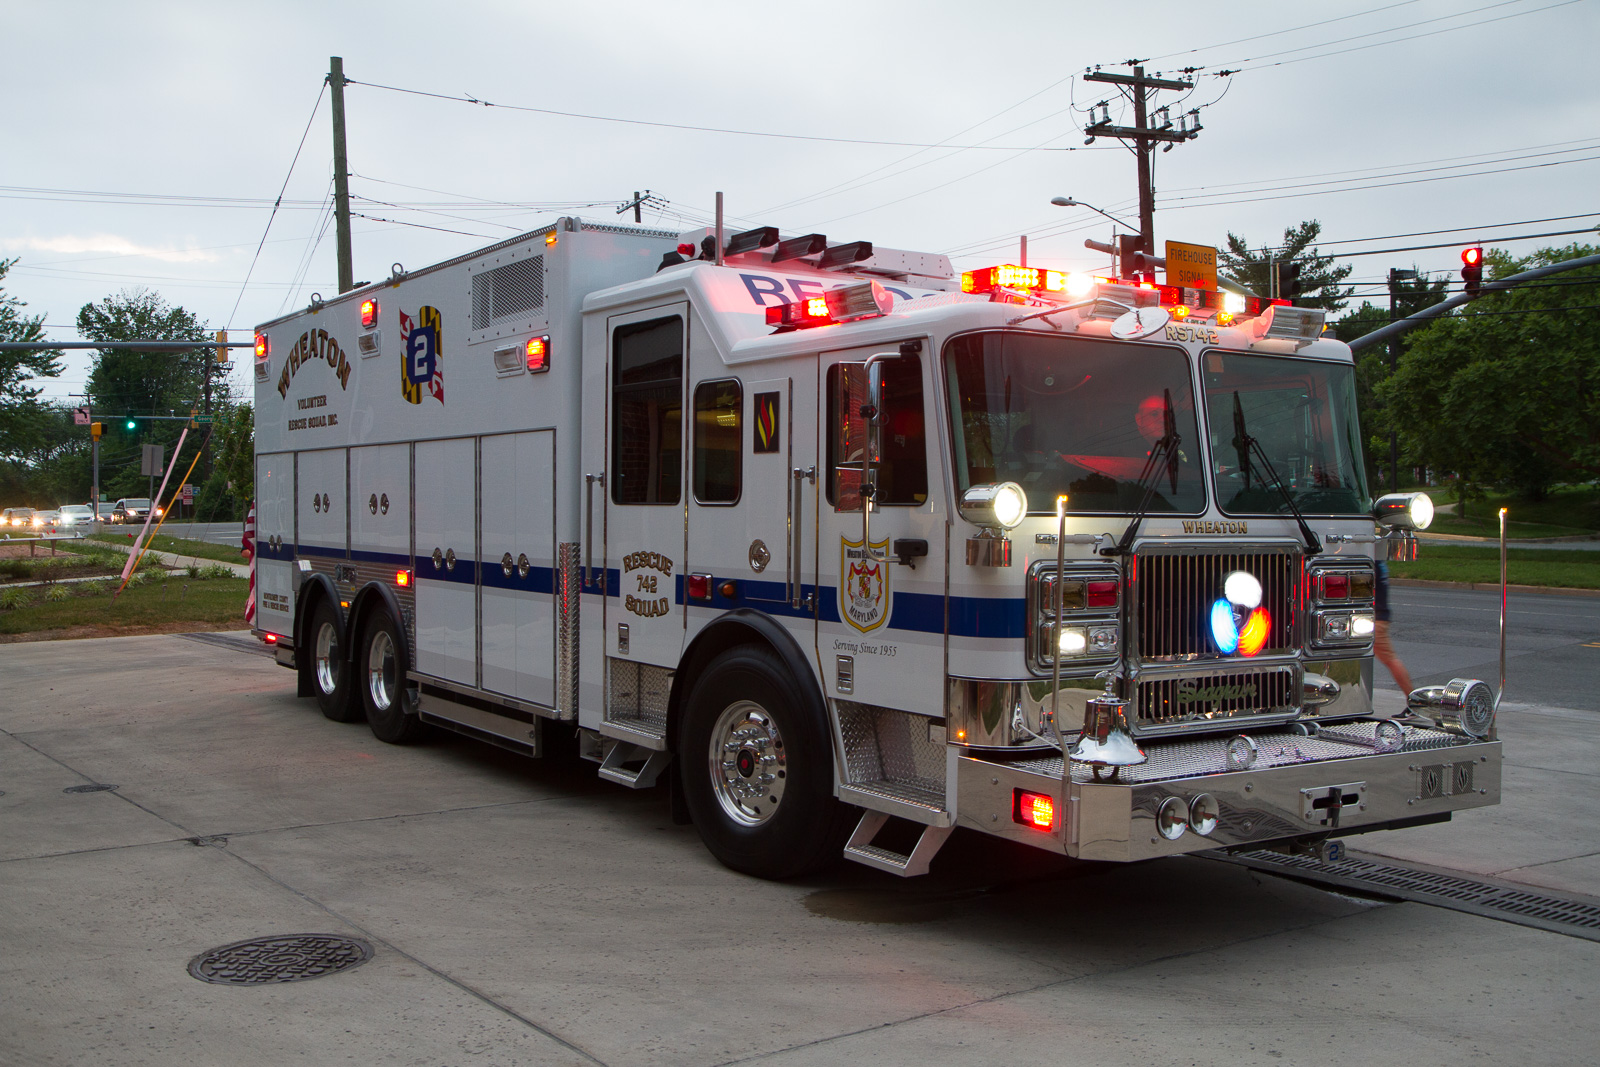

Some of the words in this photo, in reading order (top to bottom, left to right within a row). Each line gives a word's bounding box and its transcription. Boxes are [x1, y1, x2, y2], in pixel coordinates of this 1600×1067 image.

[1170, 248, 1213, 265] FIREHOUSE
[1178, 270, 1205, 284] SIGNAL
[1164, 324, 1220, 345] RS742
[277, 328, 352, 401] WHEATON
[414, 334, 428, 377] 2
[297, 394, 328, 411] VOLUNTEER
[288, 417, 307, 432] RESCUE
[1182, 520, 1248, 534] WHEATON
[623, 551, 673, 578] RESCUE
[637, 574, 658, 594] 742
[625, 594, 670, 618] SQUAD
[849, 605, 878, 622] MARYLAND
[832, 638, 859, 656] Serving
[859, 642, 878, 655] Since
[879, 645, 898, 657] 1955
[1329, 844, 1339, 861] 2
